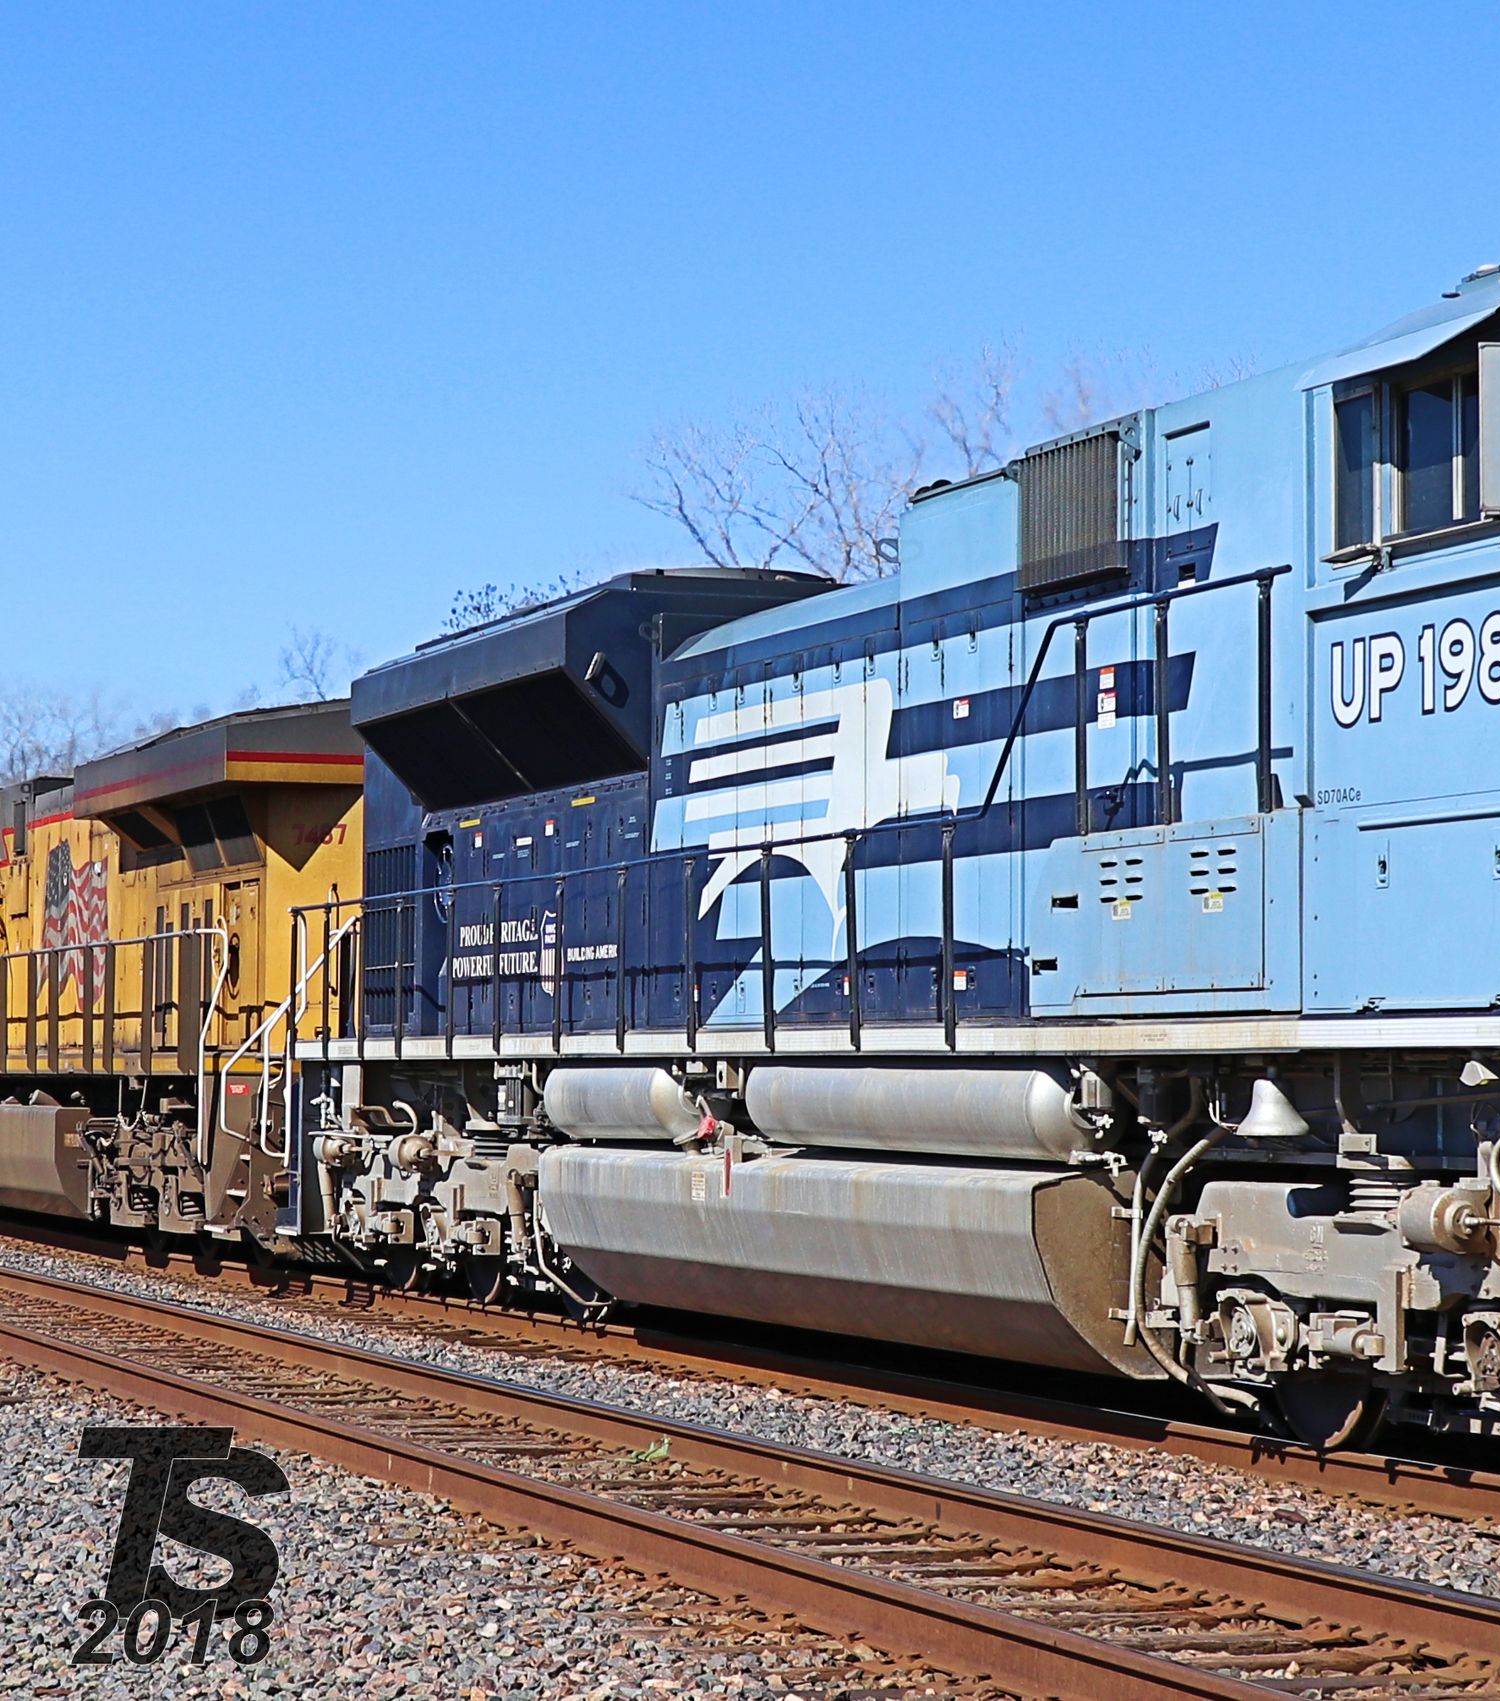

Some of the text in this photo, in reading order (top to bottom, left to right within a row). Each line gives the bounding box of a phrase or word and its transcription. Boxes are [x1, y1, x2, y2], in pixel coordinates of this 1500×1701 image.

[1330, 631, 1406, 729] UP
[1317, 787, 1362, 806] SD70ACe
[567, 946, 595, 962] BUILDING
[452, 954, 494, 979] POWERFU
